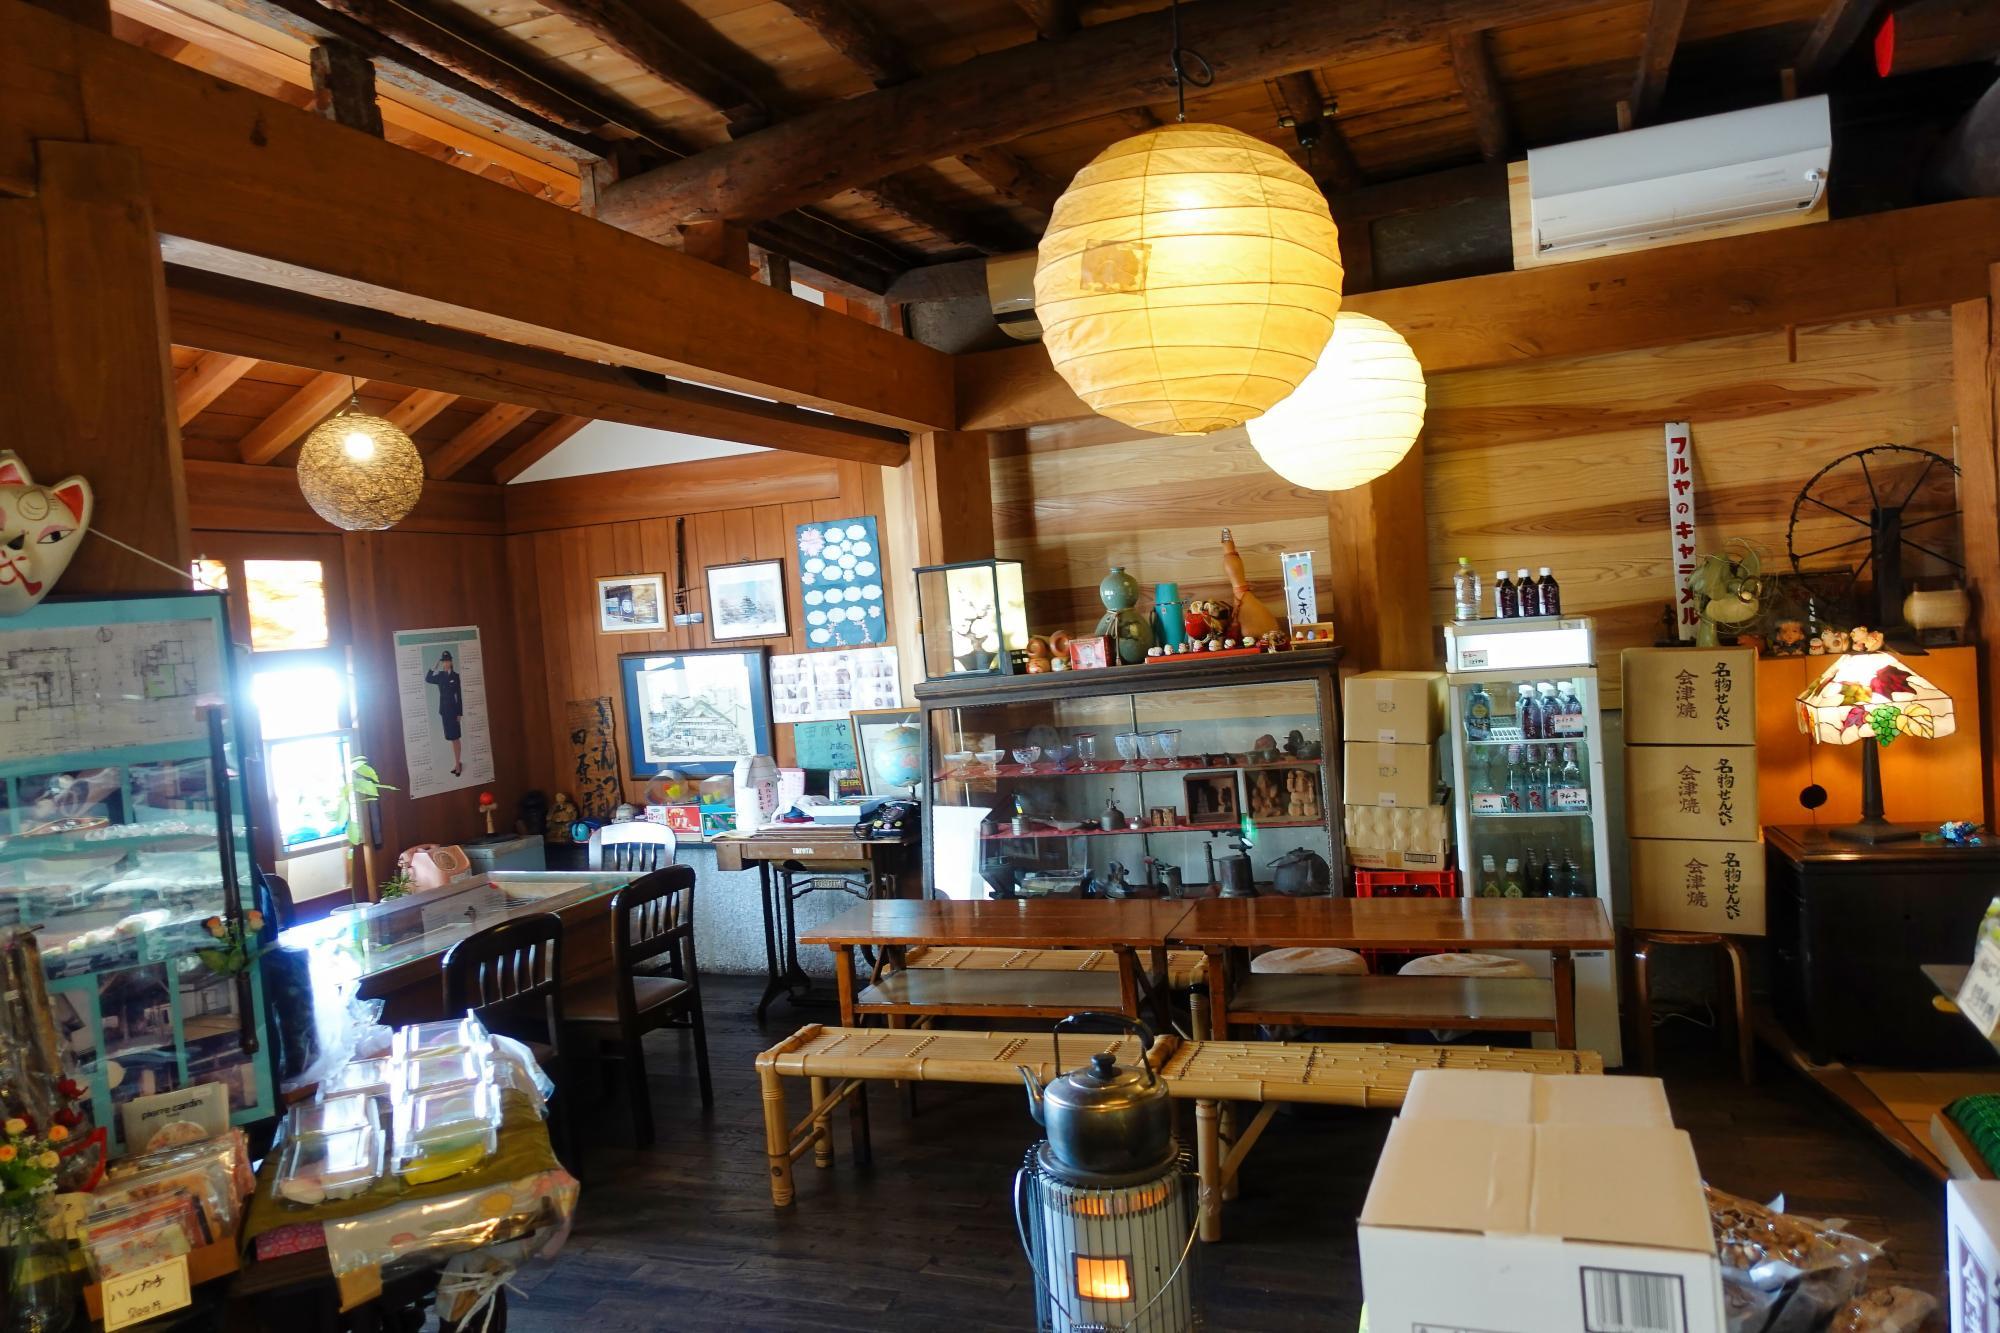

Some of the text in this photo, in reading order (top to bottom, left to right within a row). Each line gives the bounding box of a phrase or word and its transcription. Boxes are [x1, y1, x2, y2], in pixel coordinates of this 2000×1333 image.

[1675, 668, 1699, 719] 会津焼
[1711, 662, 1732, 731] 名物せんべい
[1677, 764, 1701, 815] 会津焼
[1713, 758, 1734, 827] 名物せんべい
[1684, 857, 1709, 908] 会津焼
[1721, 852, 1742, 920] 名物せんべい
[141, 1107, 170, 1120] pierre
[172, 1098, 203, 1113] cardin
